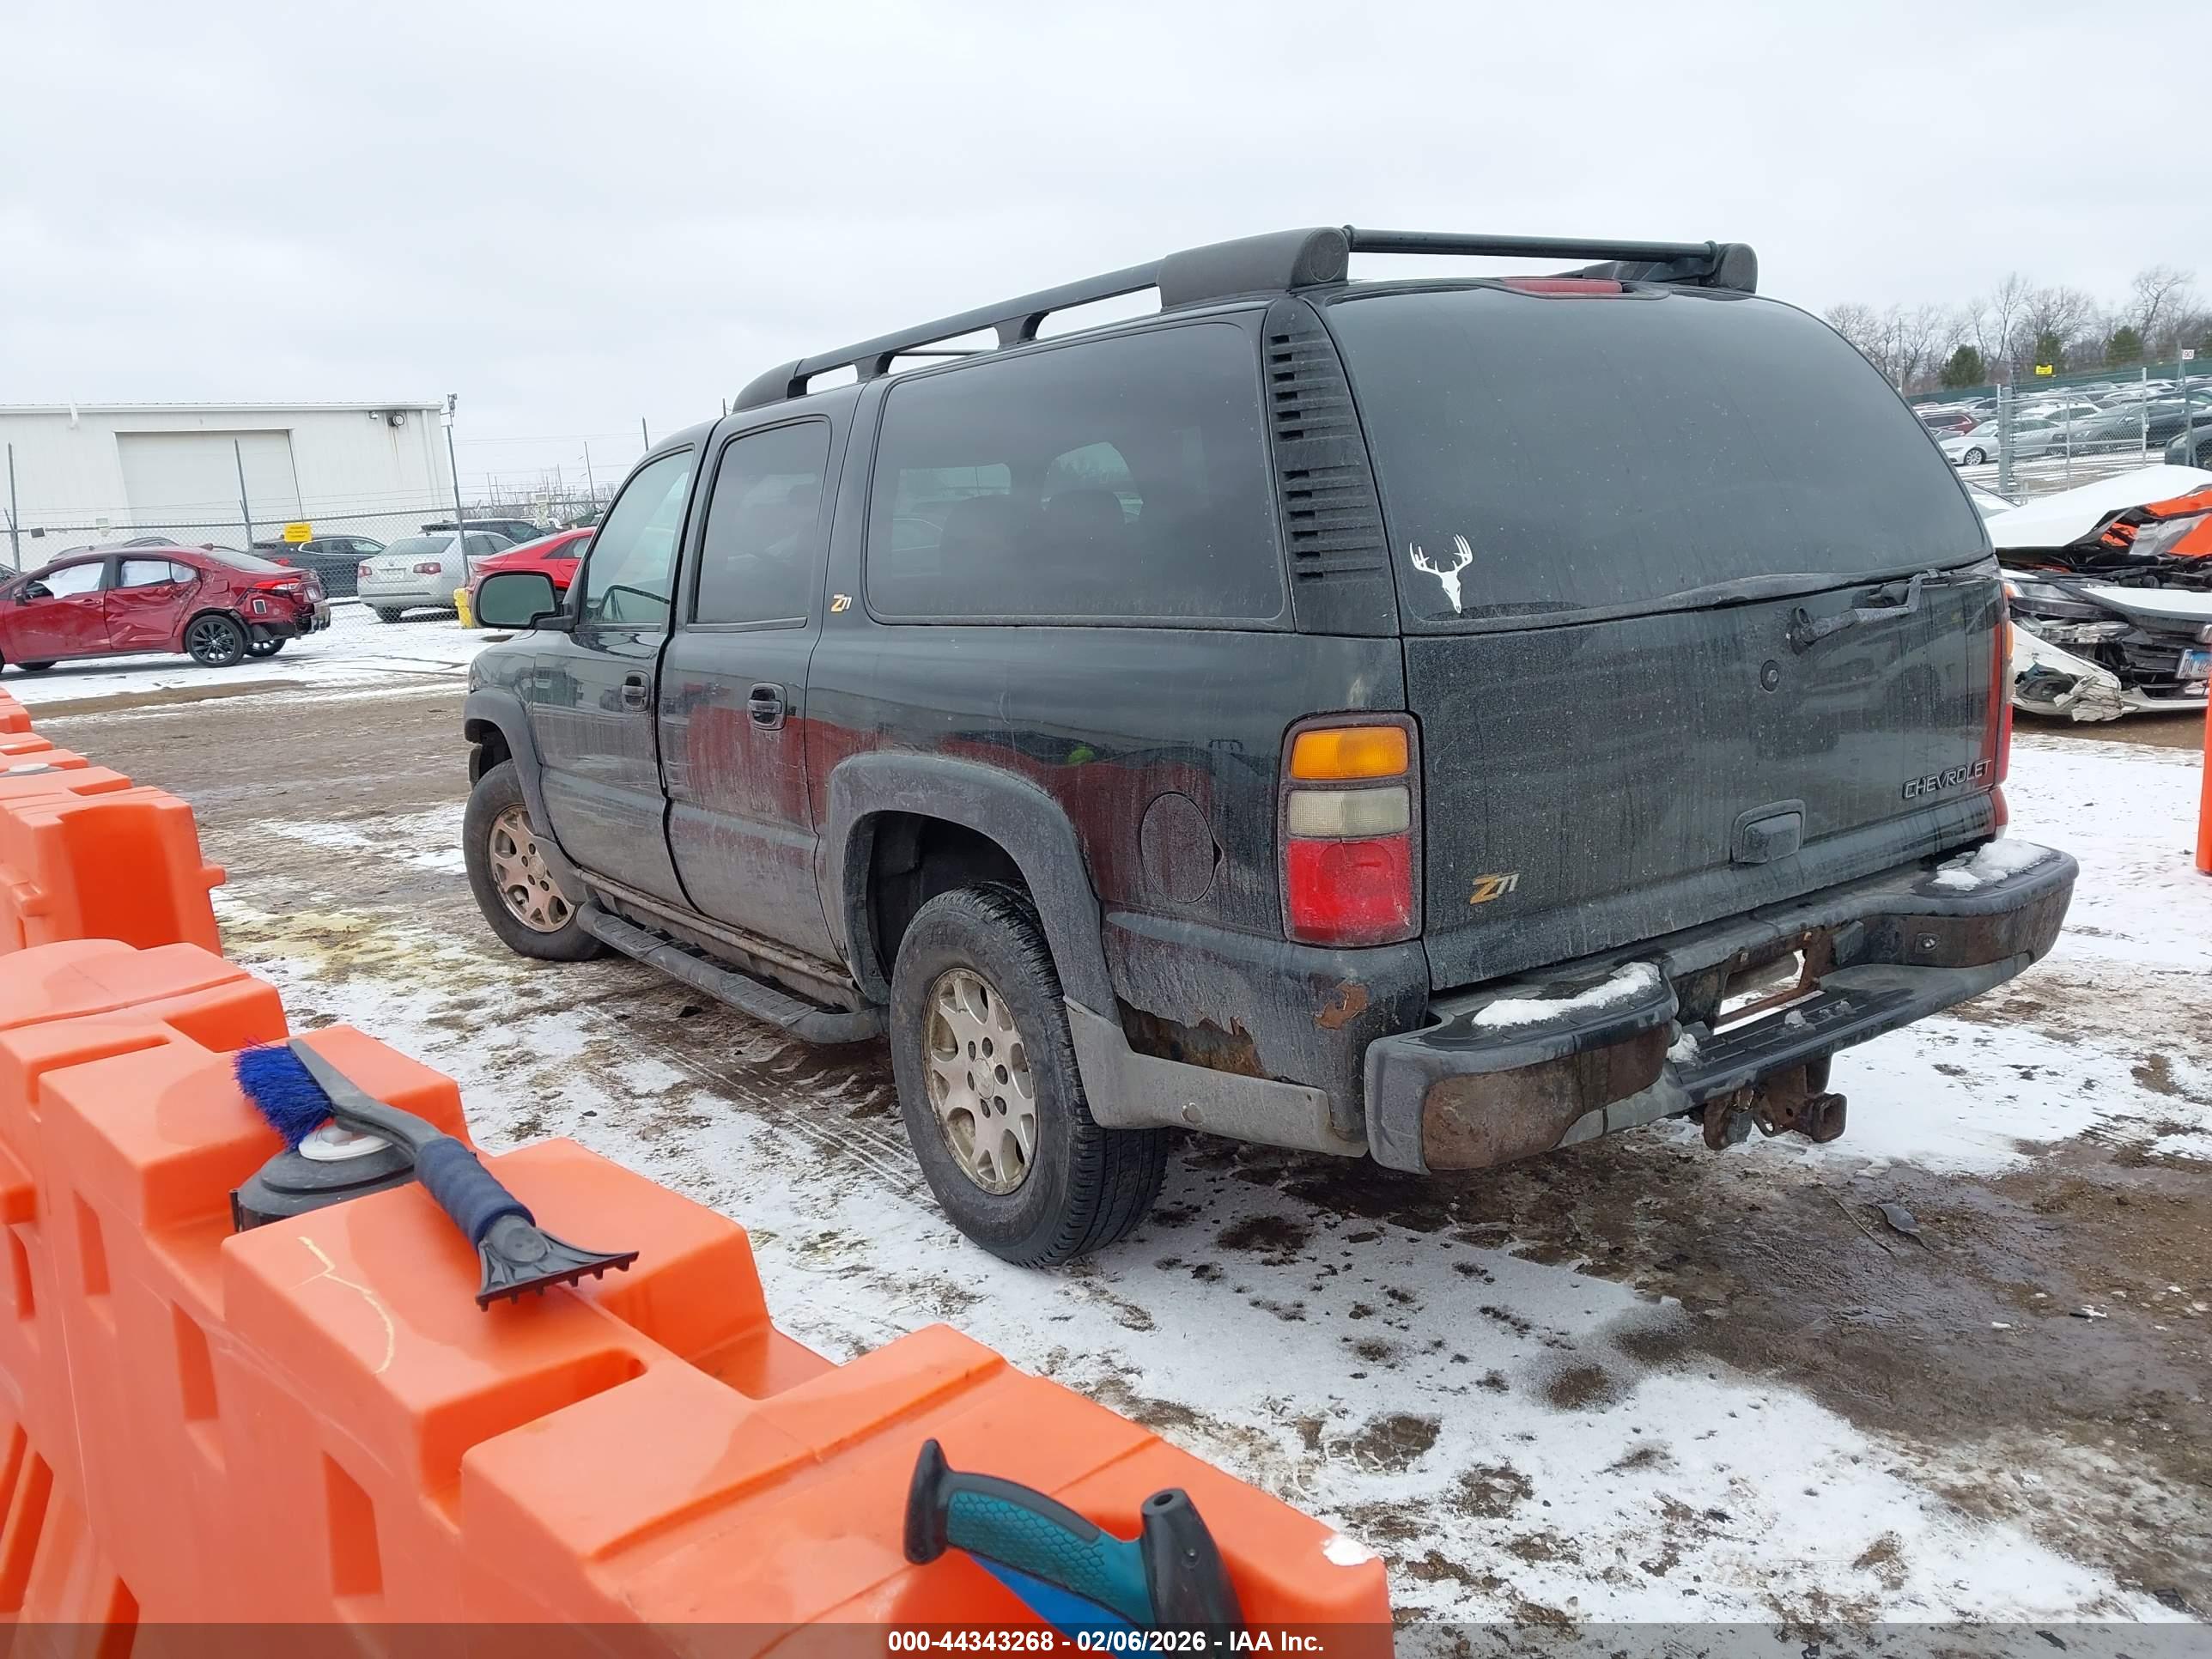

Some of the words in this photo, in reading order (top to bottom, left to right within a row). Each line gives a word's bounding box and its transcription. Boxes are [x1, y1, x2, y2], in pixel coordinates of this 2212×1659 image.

[830, 593, 853, 612] Z71
[1903, 758, 1993, 799] CHEVROLET
[1469, 872, 1520, 905] Z71
